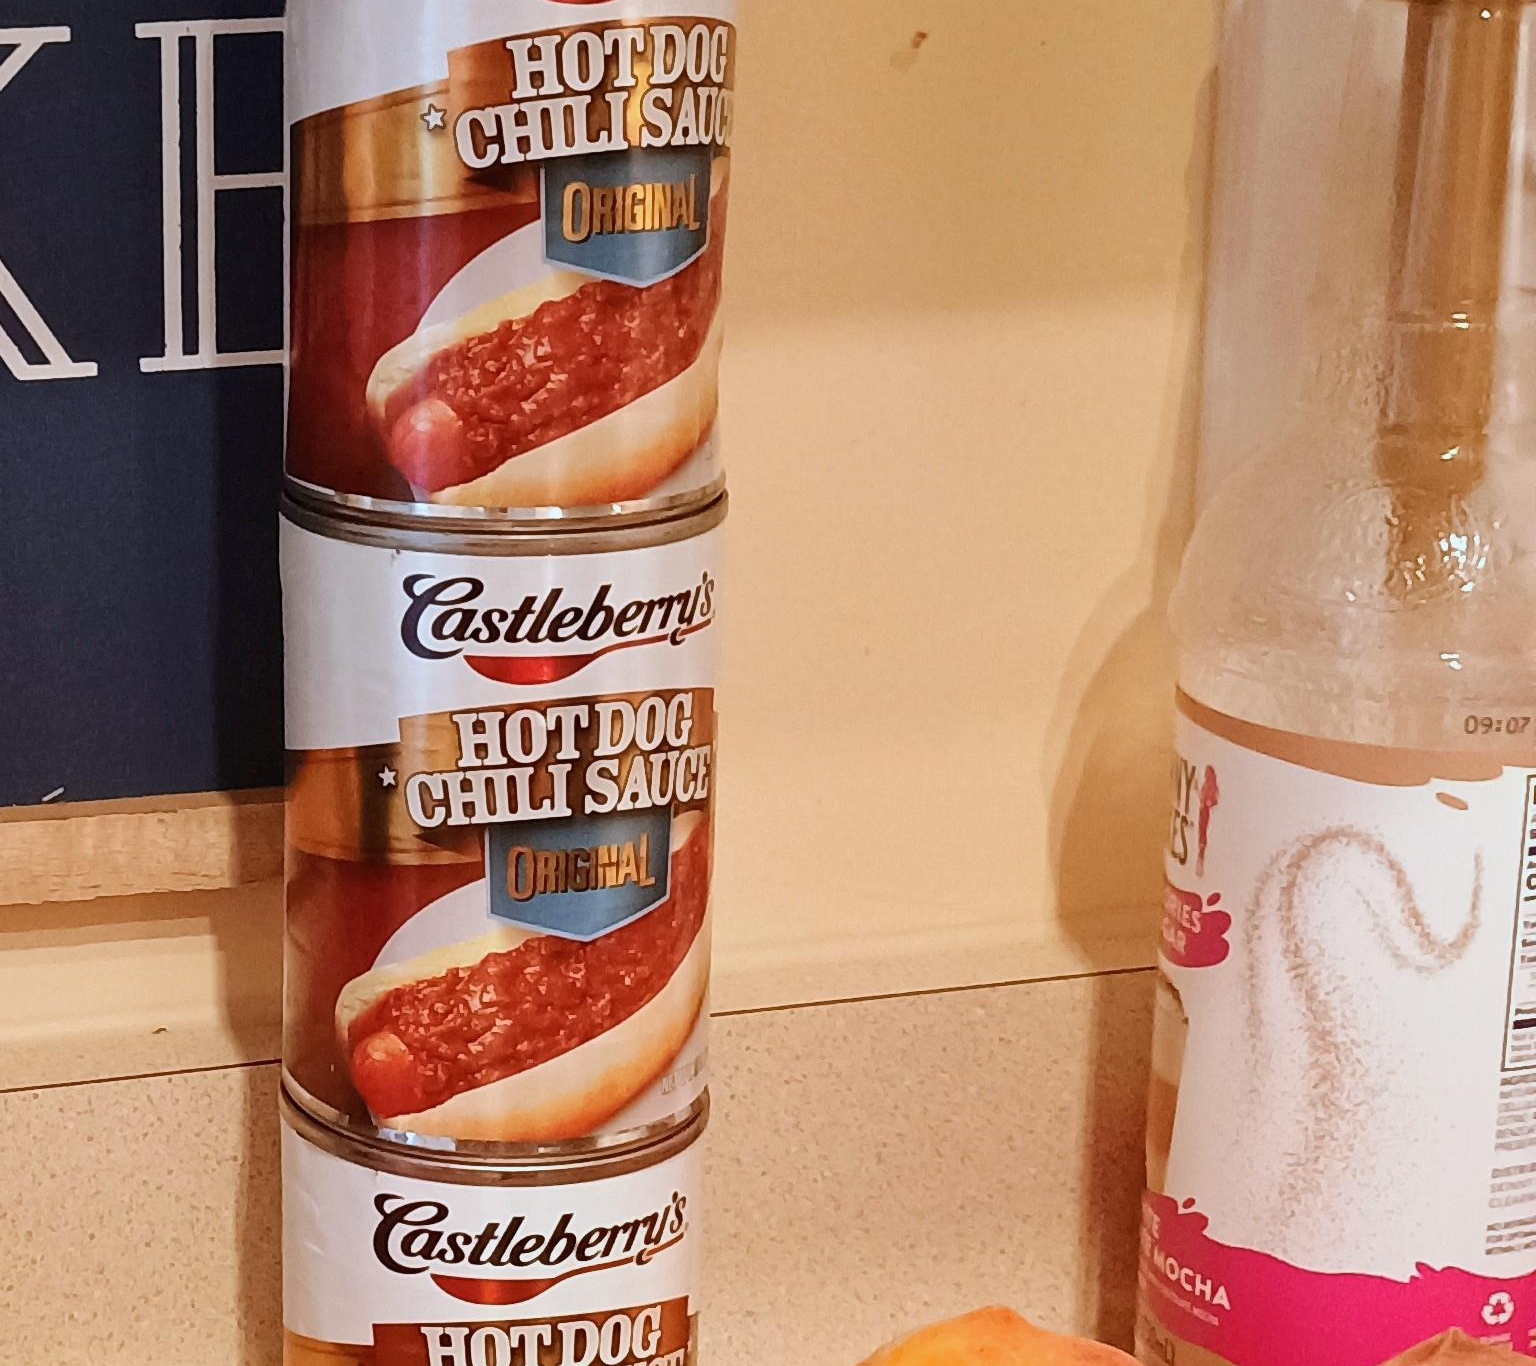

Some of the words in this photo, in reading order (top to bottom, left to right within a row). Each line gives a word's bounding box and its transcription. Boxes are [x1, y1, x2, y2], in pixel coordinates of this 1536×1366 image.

[505, 28, 646, 100] HOT
[648, 23, 729, 85] DOG
[454, 91, 630, 168] CHILI
[561, 175, 701, 242] ORIGINAL
[400, 570, 715, 660] Castleberry's
[450, 704, 591, 768] HOT
[593, 691, 694, 754] DOG
[404, 765, 572, 829] CHILI
[584, 745, 710, 815] SAUCE
[505, 834, 656, 902] ORIGINAL
[372, 1190, 688, 1275] Castleberry's
